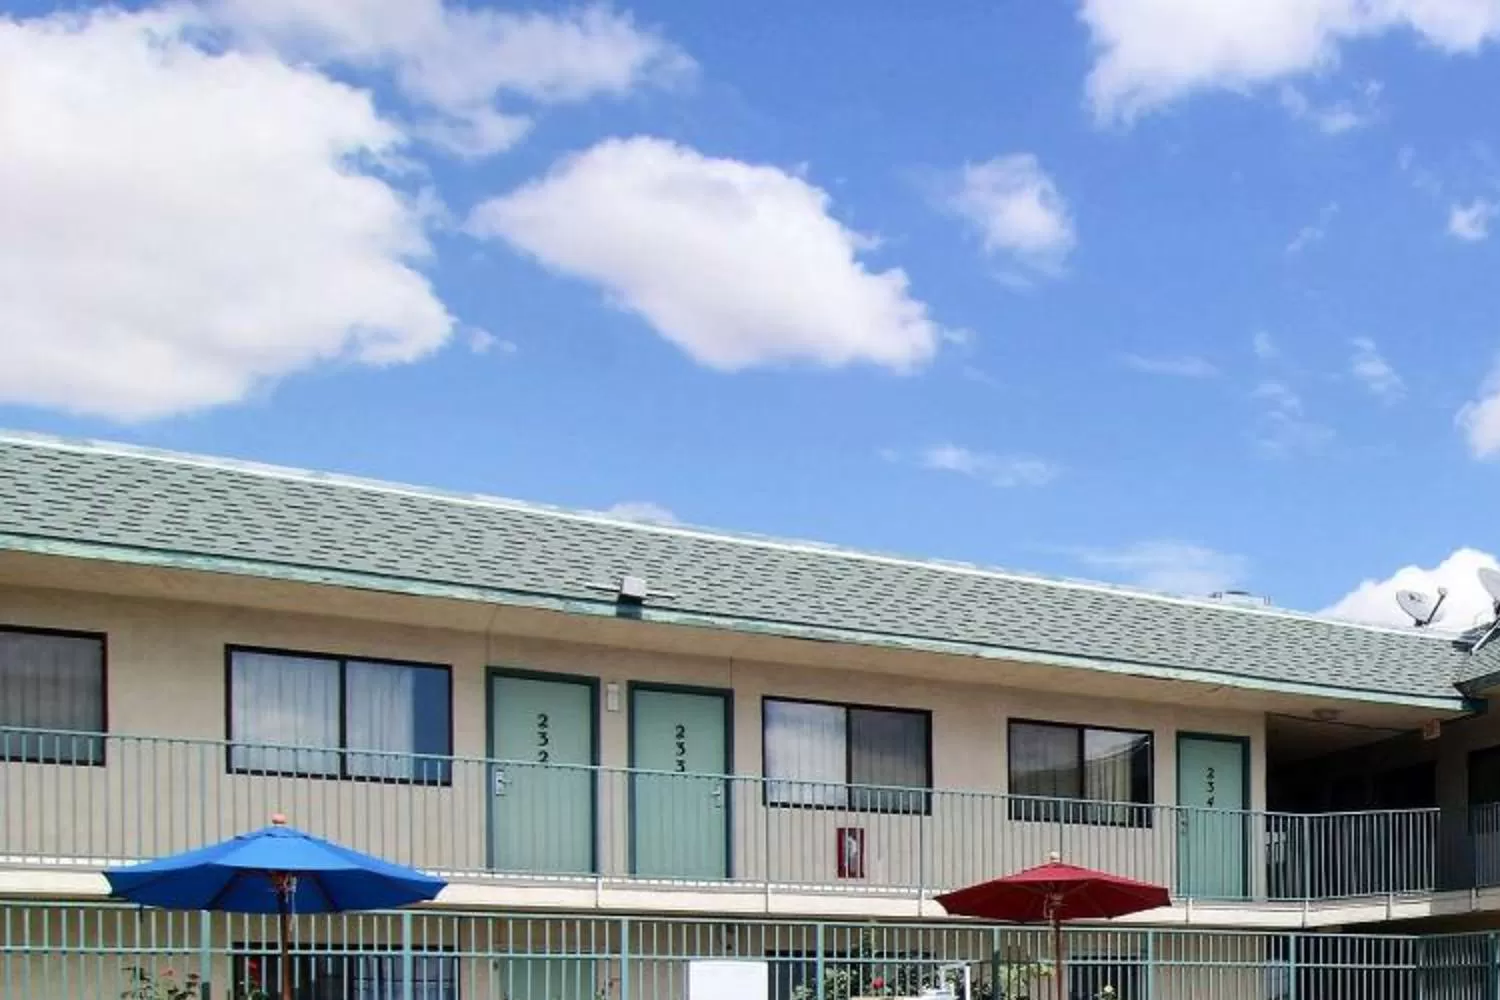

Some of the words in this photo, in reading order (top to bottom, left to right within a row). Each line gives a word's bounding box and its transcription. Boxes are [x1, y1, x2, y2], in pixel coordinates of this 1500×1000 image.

[536, 713, 549, 763] 232
[675, 724, 686, 773] 233
[1206, 767, 1215, 808] 234
